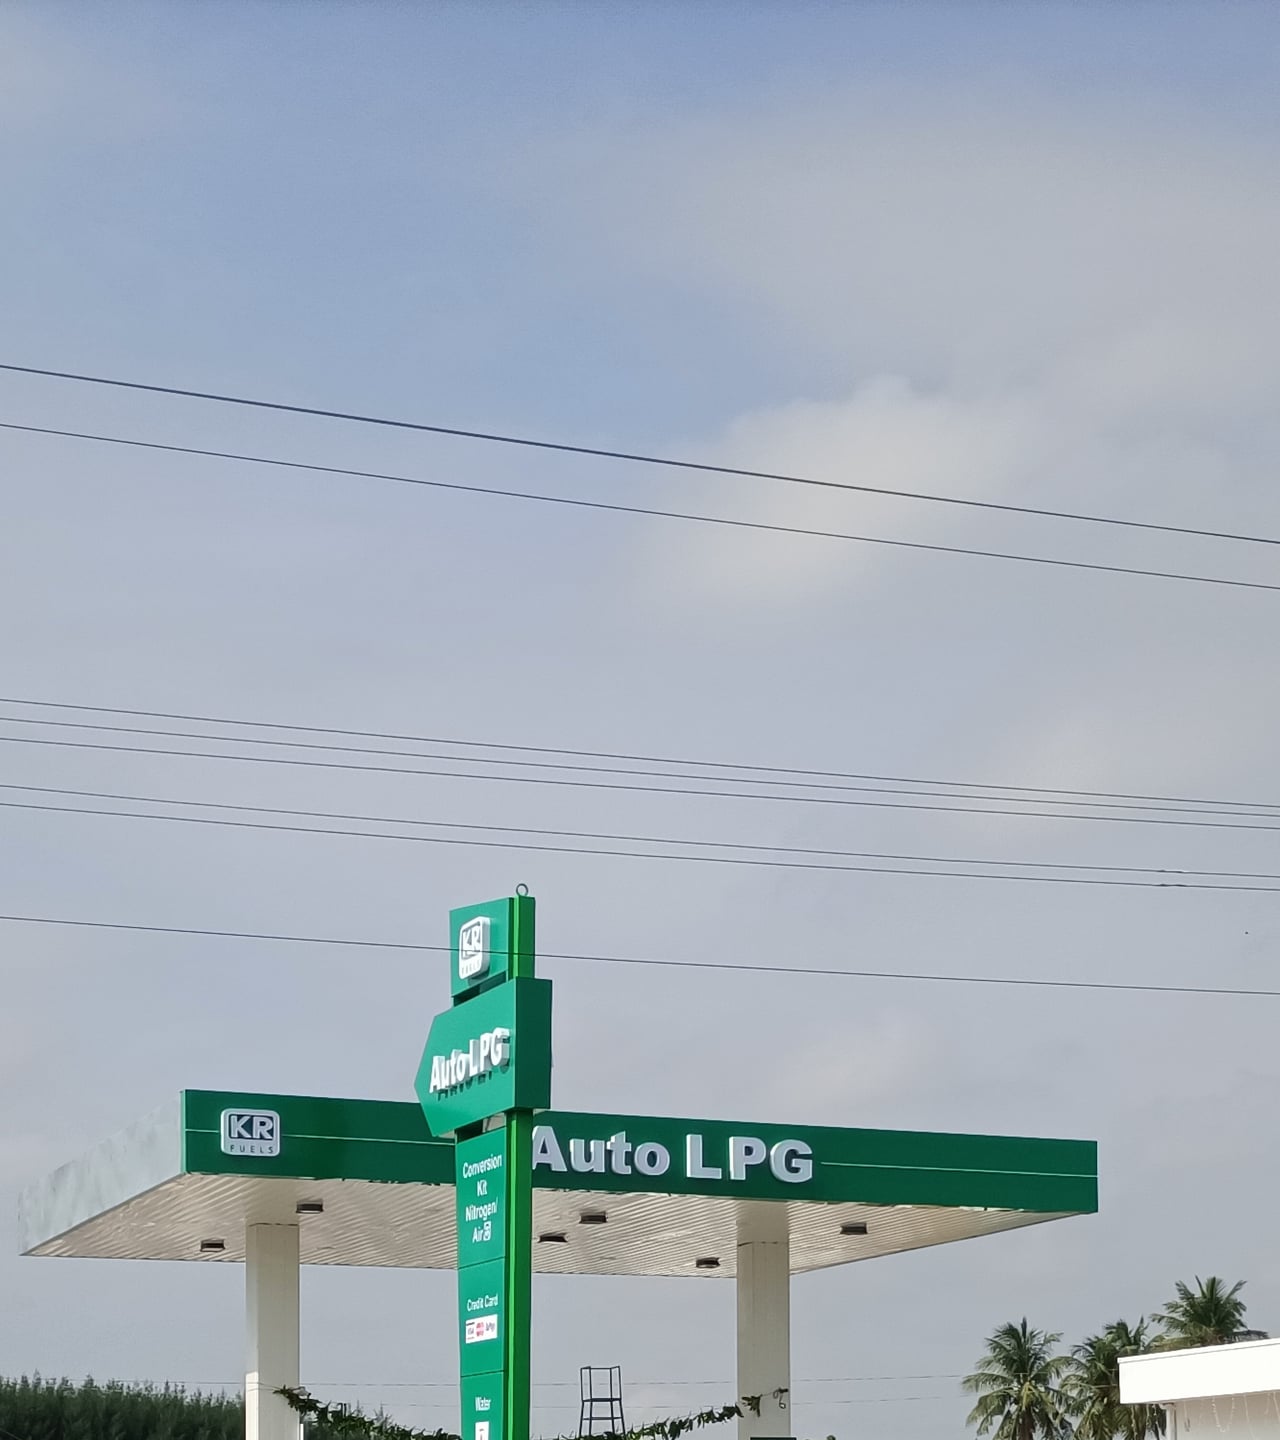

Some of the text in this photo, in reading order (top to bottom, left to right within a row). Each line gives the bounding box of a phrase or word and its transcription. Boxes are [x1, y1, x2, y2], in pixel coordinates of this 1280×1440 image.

[462, 924, 482, 958] KR
[429, 1027, 510, 1093] Auto LPG
[229, 1113, 275, 1140] KR
[230, 1144, 274, 1155] FUELS
[532, 1125, 813, 1183] Auto LPG
[462, 1153, 503, 1179] Conversion
[476, 1179, 488, 1197] Kit
[472, 1226, 484, 1244] Air
[466, 1292, 499, 1312] Credit Card
[474, 1396, 492, 1412] Water
